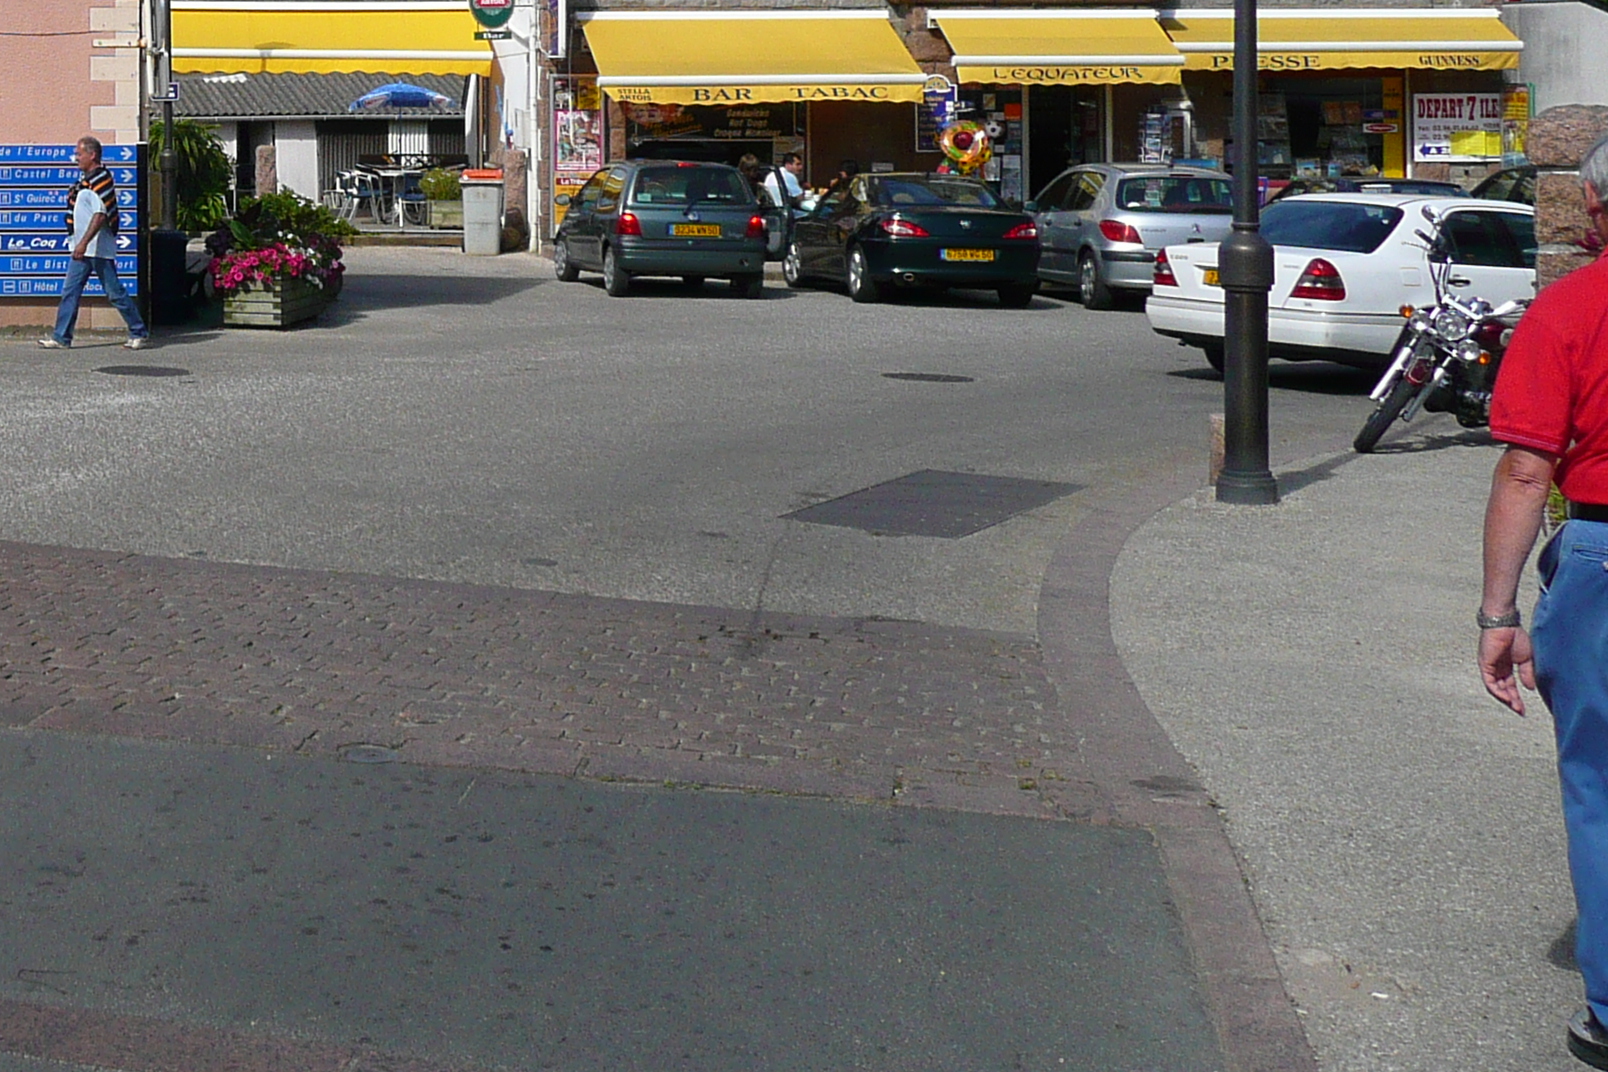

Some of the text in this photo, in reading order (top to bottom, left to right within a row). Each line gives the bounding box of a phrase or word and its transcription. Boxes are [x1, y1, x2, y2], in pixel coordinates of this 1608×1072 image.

[1212, 54, 1480, 69] PESSE GUINNESS
[993, 66, 1143, 81] L'EQUATEUR
[693, 86, 888, 101] BAR TABAC
[1417, 98, 1464, 119] DEPART
[1466, 96, 1477, 121] 7
[17, 146, 66, 159] l'Europe
[14, 169, 51, 179] Castel
[14, 194, 24, 204] St
[26, 193, 56, 203] Guirec
[13, 213, 59, 223] du Parc
[8, 237, 25, 247] Le
[31, 237, 57, 249] Coq
[26, 259, 134, 269] Le Bist ort
[34, 281, 58, 292] Hôtel
